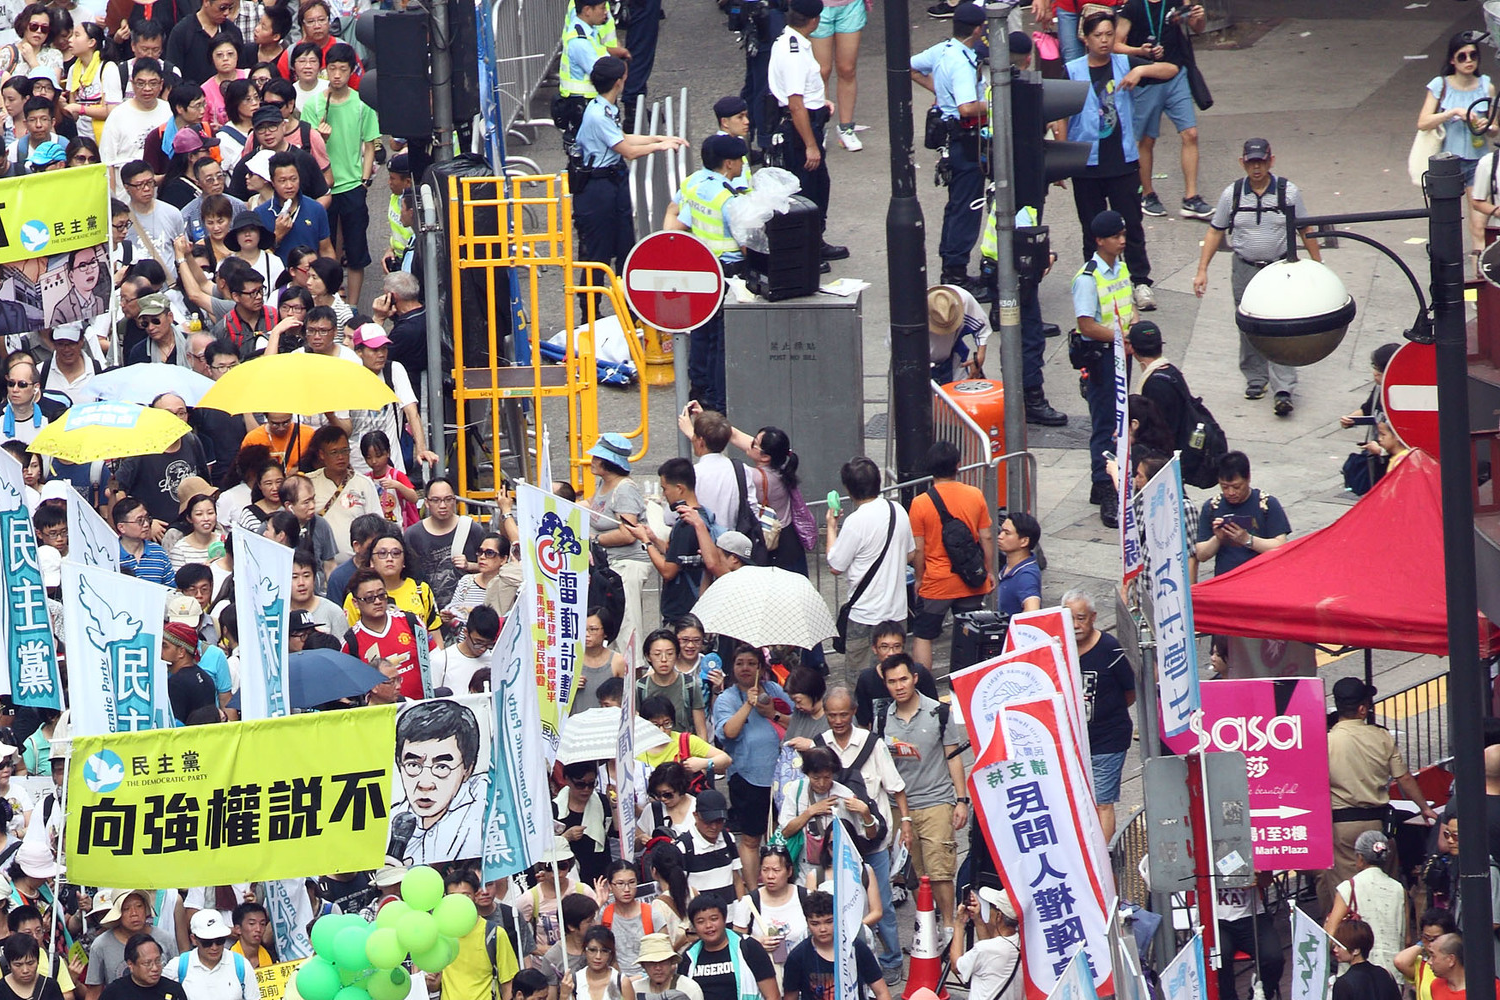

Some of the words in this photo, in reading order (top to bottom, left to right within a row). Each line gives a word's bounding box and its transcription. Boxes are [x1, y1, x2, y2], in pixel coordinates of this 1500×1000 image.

[54, 215, 97, 236] 民主黨
[8, 517, 54, 698] 民主黨
[558, 571, 579, 704] 雷動計劃
[132, 750, 202, 776] 民主黨
[126, 779, 140, 788] THE
[141, 775, 186, 786] DEMOCRATIC
[187, 773, 208, 782] PARTY
[1255, 845, 1279, 855] Mark
[1280, 845, 1309, 856] Plaza
